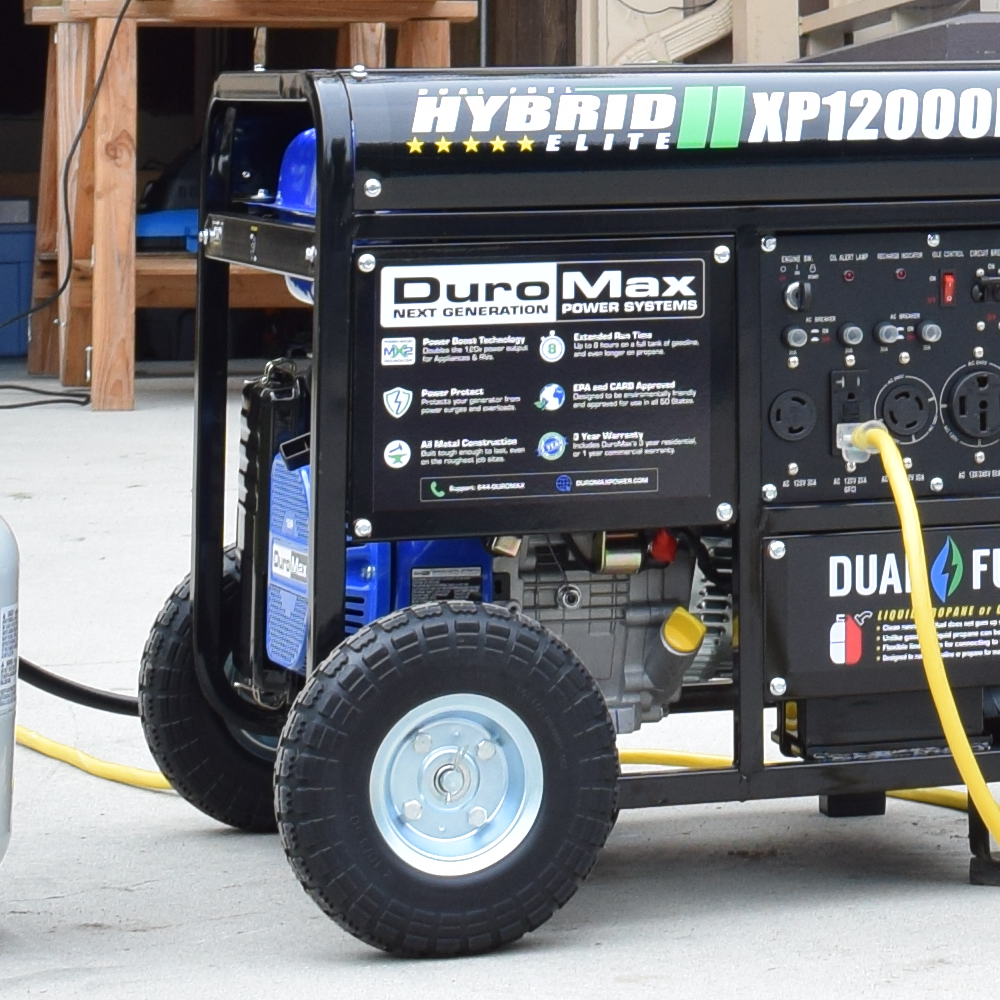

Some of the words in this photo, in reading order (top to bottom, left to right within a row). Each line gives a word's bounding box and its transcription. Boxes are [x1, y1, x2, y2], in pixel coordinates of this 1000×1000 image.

[411, 93, 677, 133] HYBRID
[545, 132, 672, 152] ELITE
[394, 276, 550, 304] Duro
[562, 270, 697, 300] Max
[394, 308, 437, 319] NEXT
[443, 304, 548, 317] GENERATION
[562, 302, 619, 314] POWER
[624, 300, 698, 312] SYSTEMS
[422, 338, 450, 346] Power
[574, 332, 612, 342] Extended
[632, 331, 652, 340] Time
[548, 343, 556, 354] 8
[573, 383, 591, 392] EPA
[592, 382, 608, 391] and
[610, 382, 634, 390] CARB
[636, 380, 676, 391] Approved
[422, 388, 449, 397] Power
[450, 388, 484, 396] Protect
[581, 432, 601, 440] Year
[602, 432, 644, 441] Warranty
[420, 440, 432, 449] All
[434, 439, 460, 448] Metal
[462, 437, 518, 448] Construction
[933, 606, 974, 619] OPANE
[979, 605, 992, 616] or
